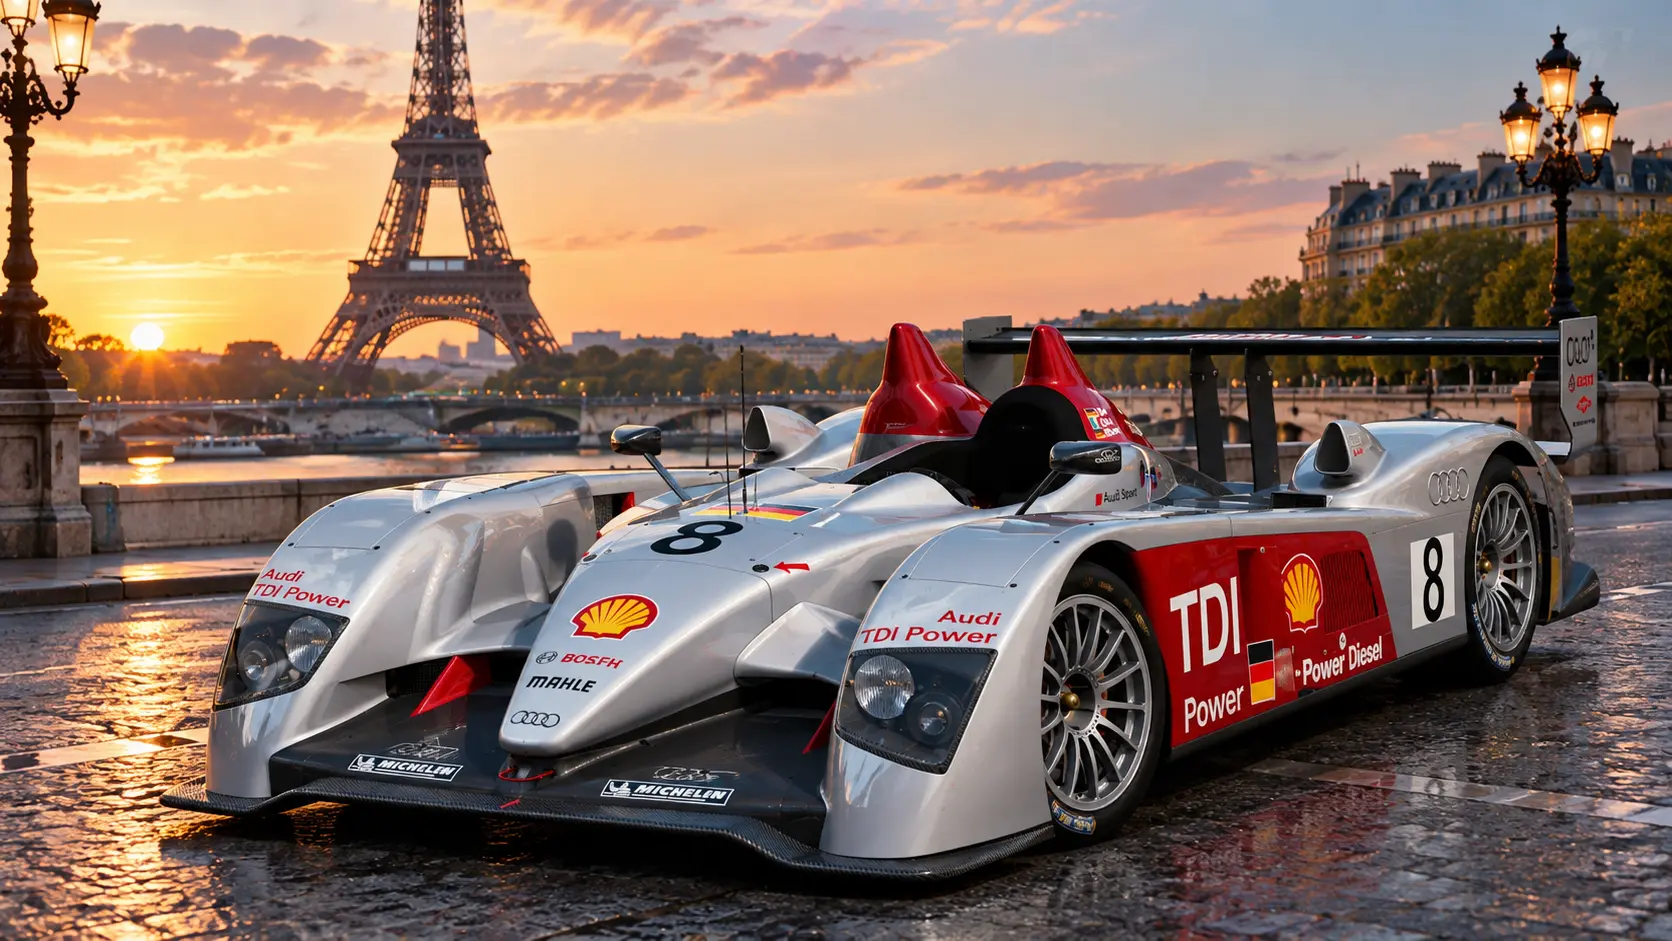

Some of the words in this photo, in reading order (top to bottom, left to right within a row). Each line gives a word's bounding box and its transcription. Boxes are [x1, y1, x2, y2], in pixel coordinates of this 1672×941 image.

[650, 520, 744, 555] 8
[261, 568, 305, 582] Audi
[1423, 536, 1445, 623] 8
[253, 583, 284, 598] TDI
[282, 586, 351, 609] Power
[937, 610, 1002, 626] Audi
[1169, 576, 1241, 674] TDI
[861, 626, 899, 644] TDI
[905, 626, 998, 644] Power
[1302, 656, 1346, 686] Power
[1348, 635, 1383, 671] Diesel
[526, 675, 597, 693] MAHLE
[1184, 685, 1245, 734] Power
